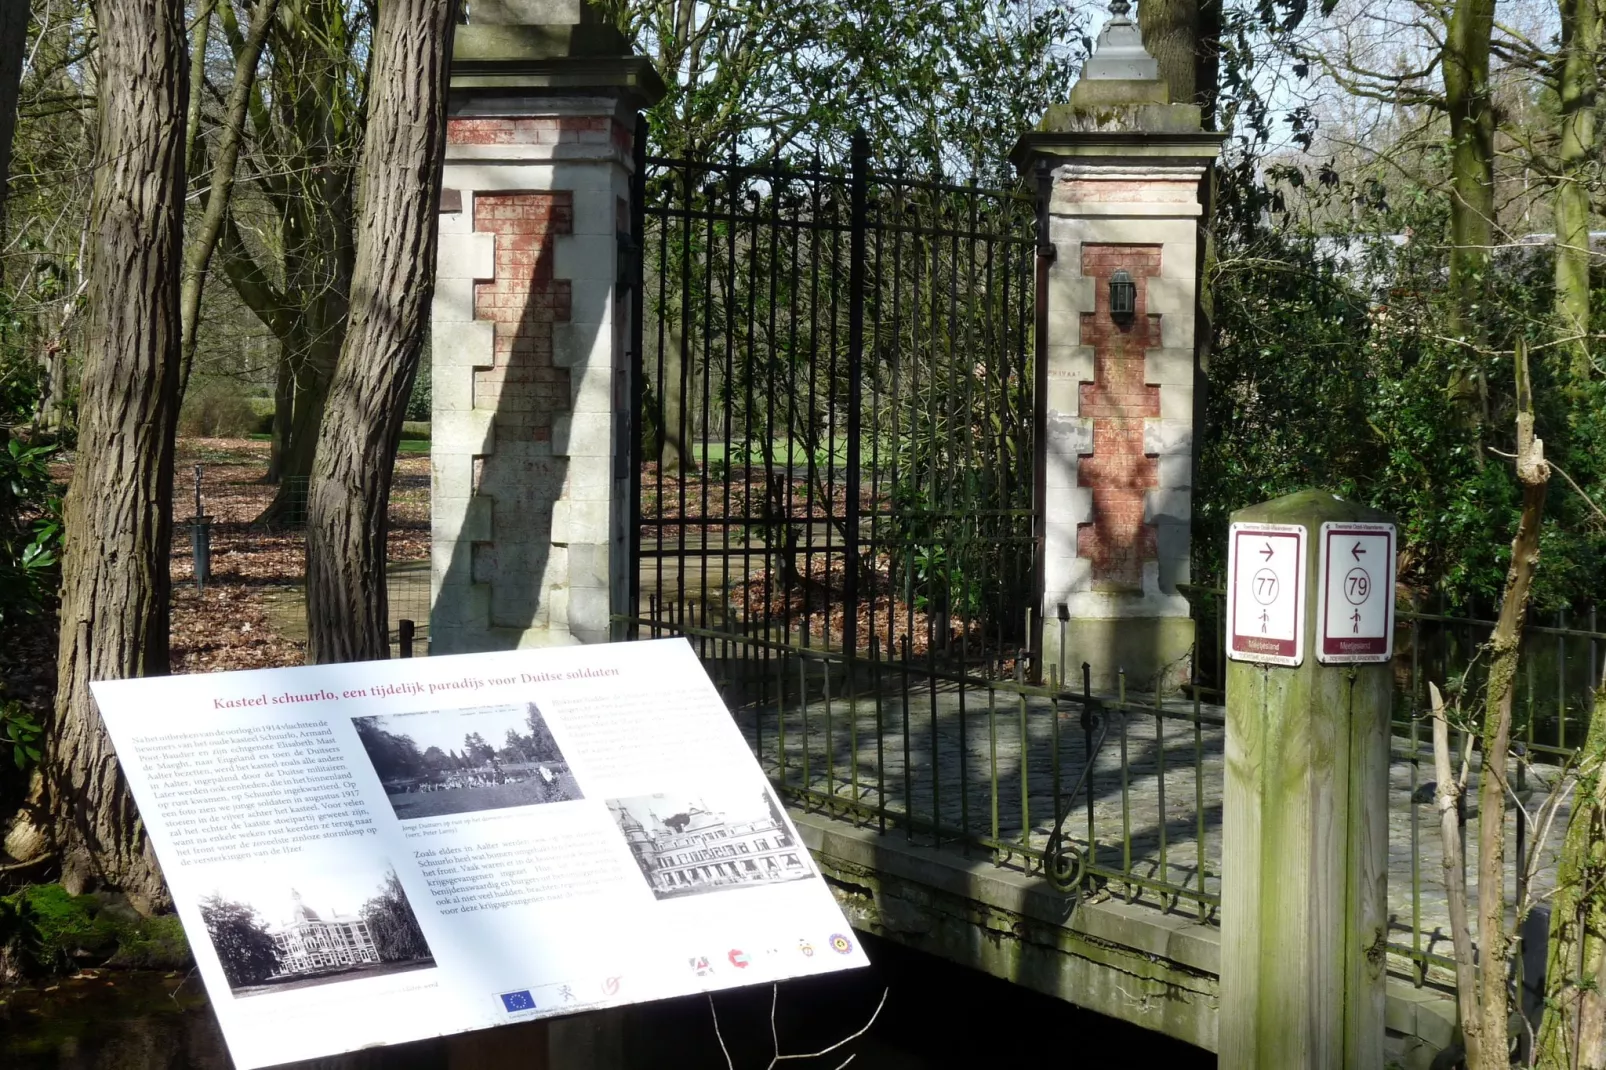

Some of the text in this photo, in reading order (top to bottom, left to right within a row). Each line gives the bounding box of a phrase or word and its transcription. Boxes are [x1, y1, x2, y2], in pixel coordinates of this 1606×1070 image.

[1258, 577, 1276, 596] 77
[1349, 577, 1368, 596] 79
[213, 667, 619, 709] Kasteel schuurlo, een tijdelijk paradijs voor Duitse soldaten
[229, 735, 258, 743] kasteel
[259, 732, 298, 740] Schuurlo,
[299, 727, 332, 737] Armand
[230, 744, 273, 752] echtgenote
[276, 739, 313, 748] Elisabeth
[216, 754, 255, 763] Engeland
[214, 764, 234, 772] werd
[250, 760, 278, 769] kasteel
[194, 774, 238, 784] ingepalmd
[306, 764, 348, 772] militairen.
[177, 787, 208, 795] werden
[226, 781, 270, 790] eenheden,
[306, 771, 352, 782] binnenland
[243, 789, 281, 798] Schuurlo
[304, 793, 339, 802] augustus
[341, 789, 359, 797] 1917
[169, 828, 181, 836] zal
[273, 815, 314, 824] stoeipartij
[317, 810, 348, 821] geweest
[209, 832, 236, 841] enkele
[285, 824, 318, 832] keerden
[252, 837, 288, 846] zoveelste
[292, 834, 320, 842] zinloze
[322, 828, 364, 838] stormloop
[194, 852, 251, 863] versterkingen
[412, 848, 436, 858] Zoals
[438, 846, 461, 855] elders
[417, 857, 453, 867] Schuurlo
[453, 854, 470, 862] heel
[426, 873, 493, 886] krijgsgevangenen
[430, 882, 500, 896] benijdenswaardig
[435, 897, 451, 905] ook
[477, 891, 493, 899] veel
[478, 896, 544, 909] krijgsgevangenen
